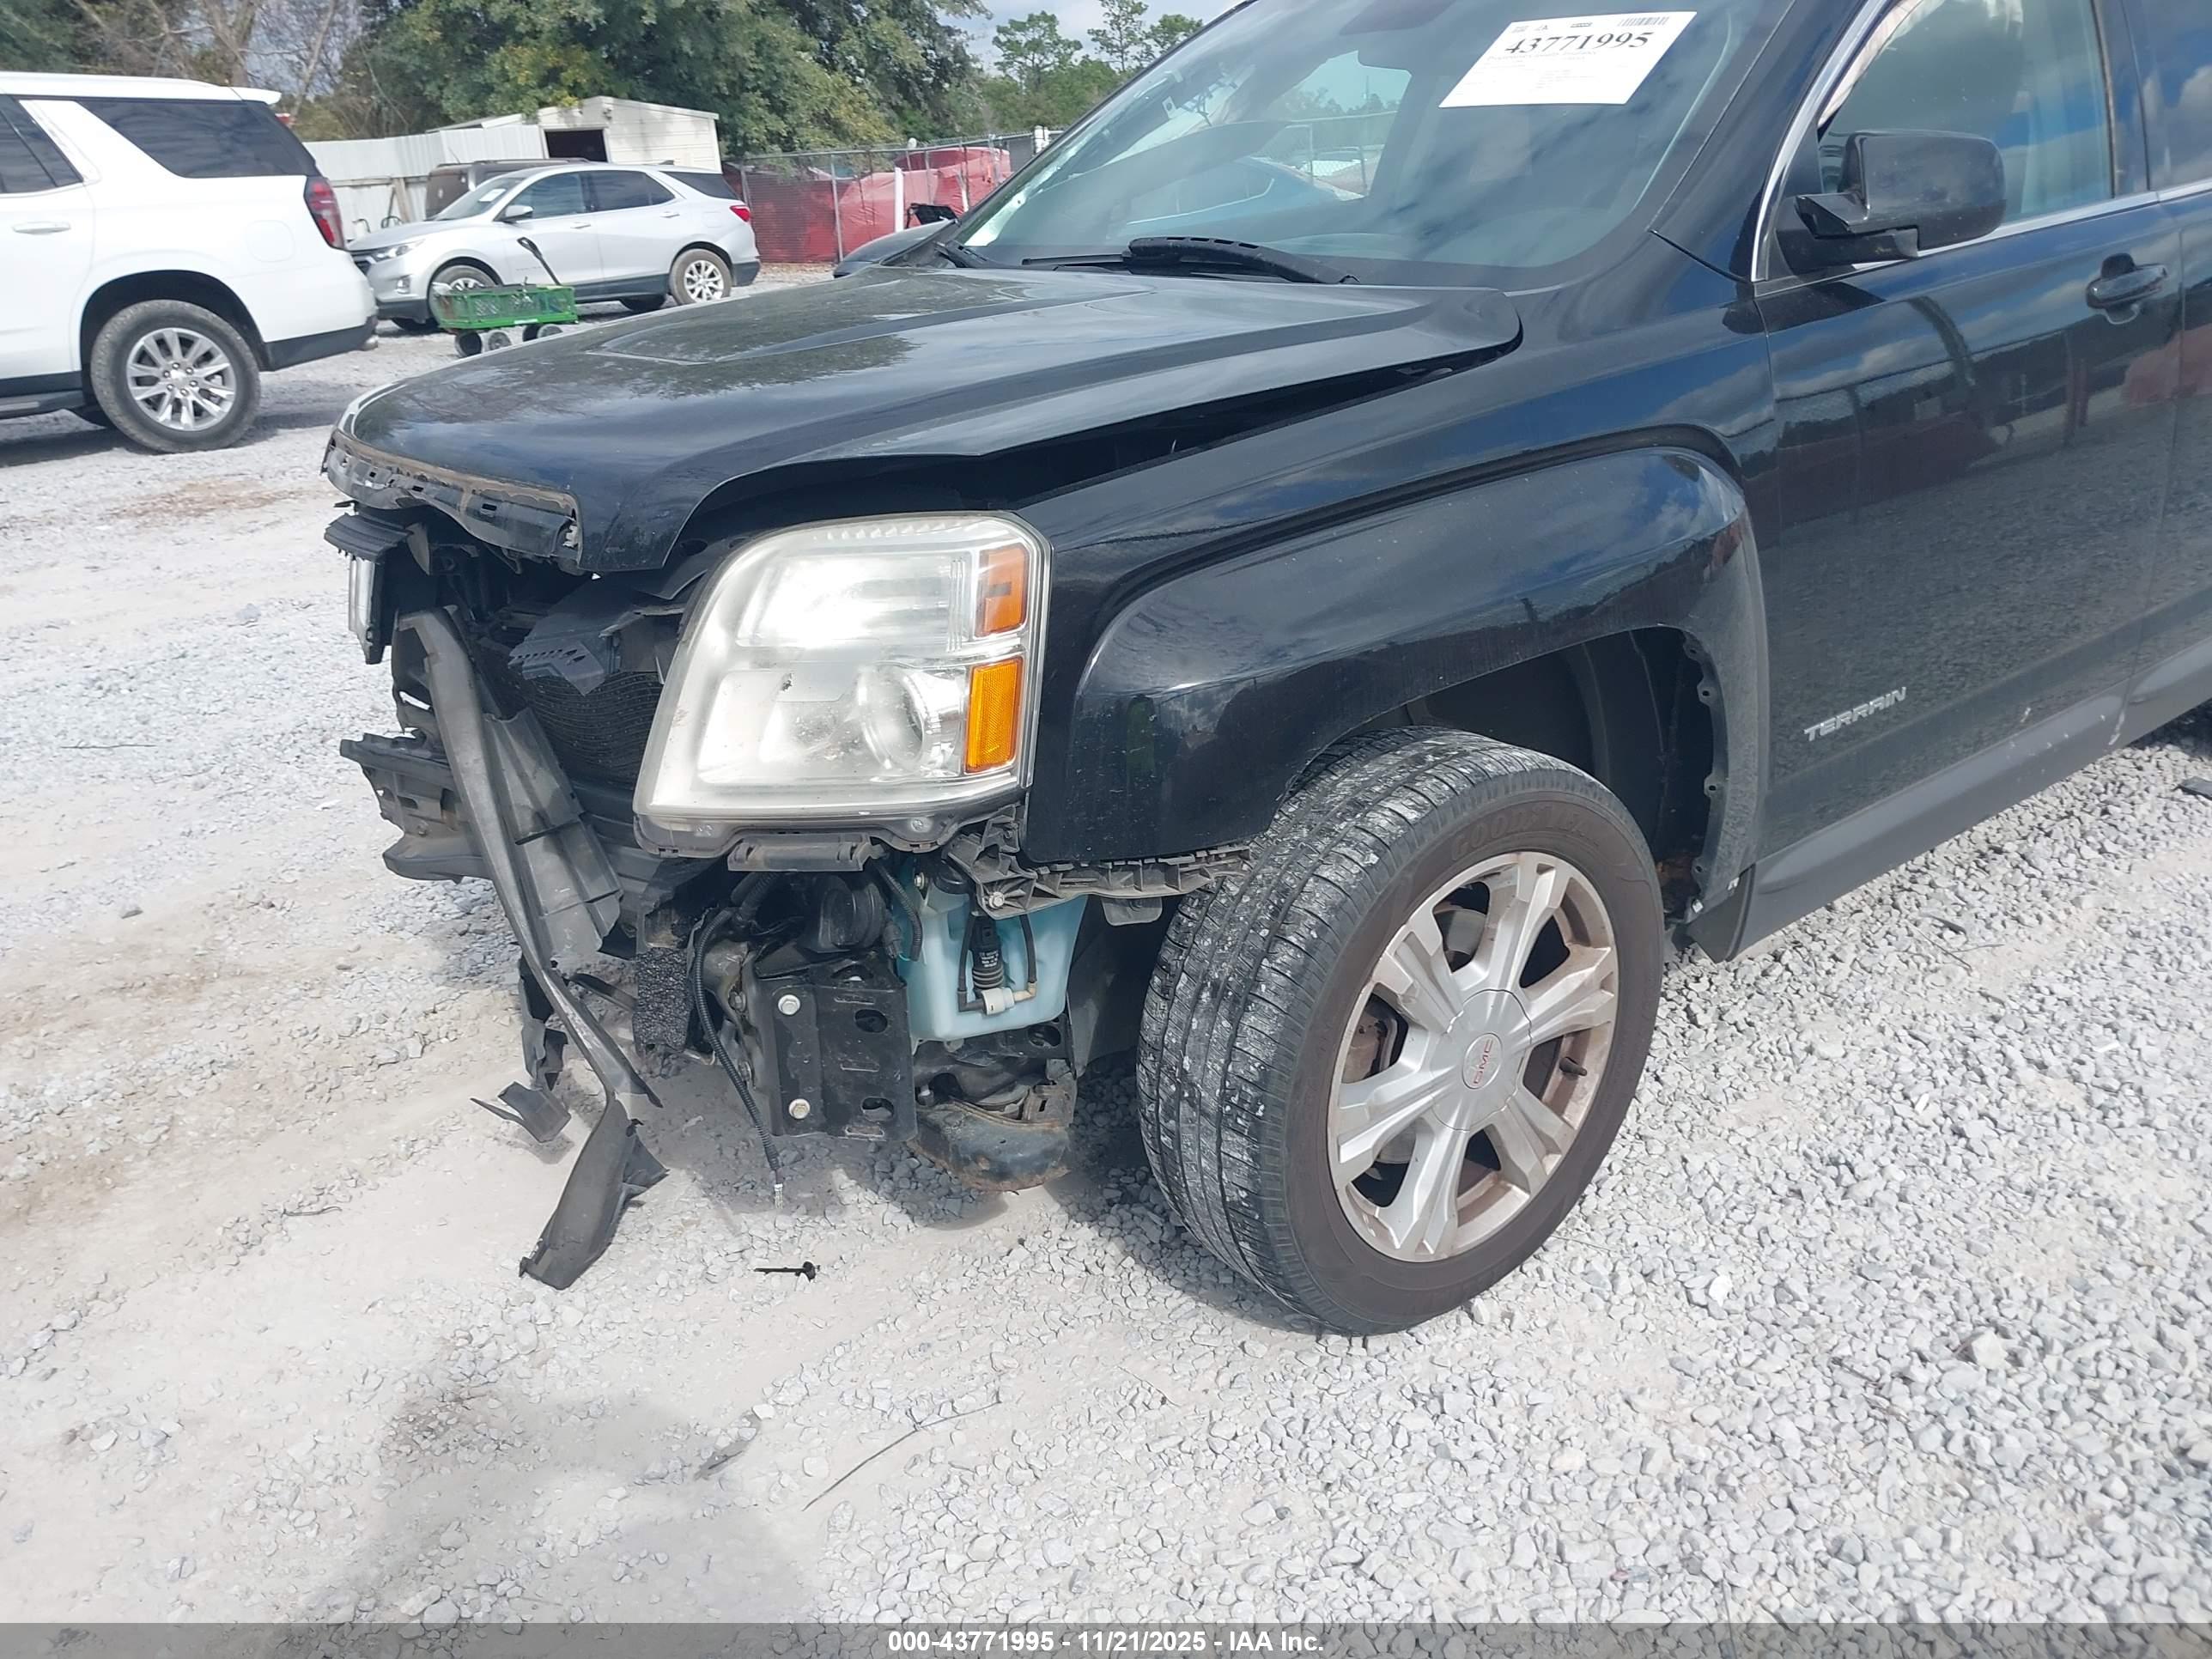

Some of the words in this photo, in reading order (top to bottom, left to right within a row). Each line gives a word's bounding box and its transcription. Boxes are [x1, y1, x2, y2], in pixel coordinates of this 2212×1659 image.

[1504, 31, 1655, 54] 43771995
[1803, 686, 1907, 742] TERRAIN
[1450, 805, 1599, 860] GOODYEA
[1473, 1038, 1494, 1085] GMC
